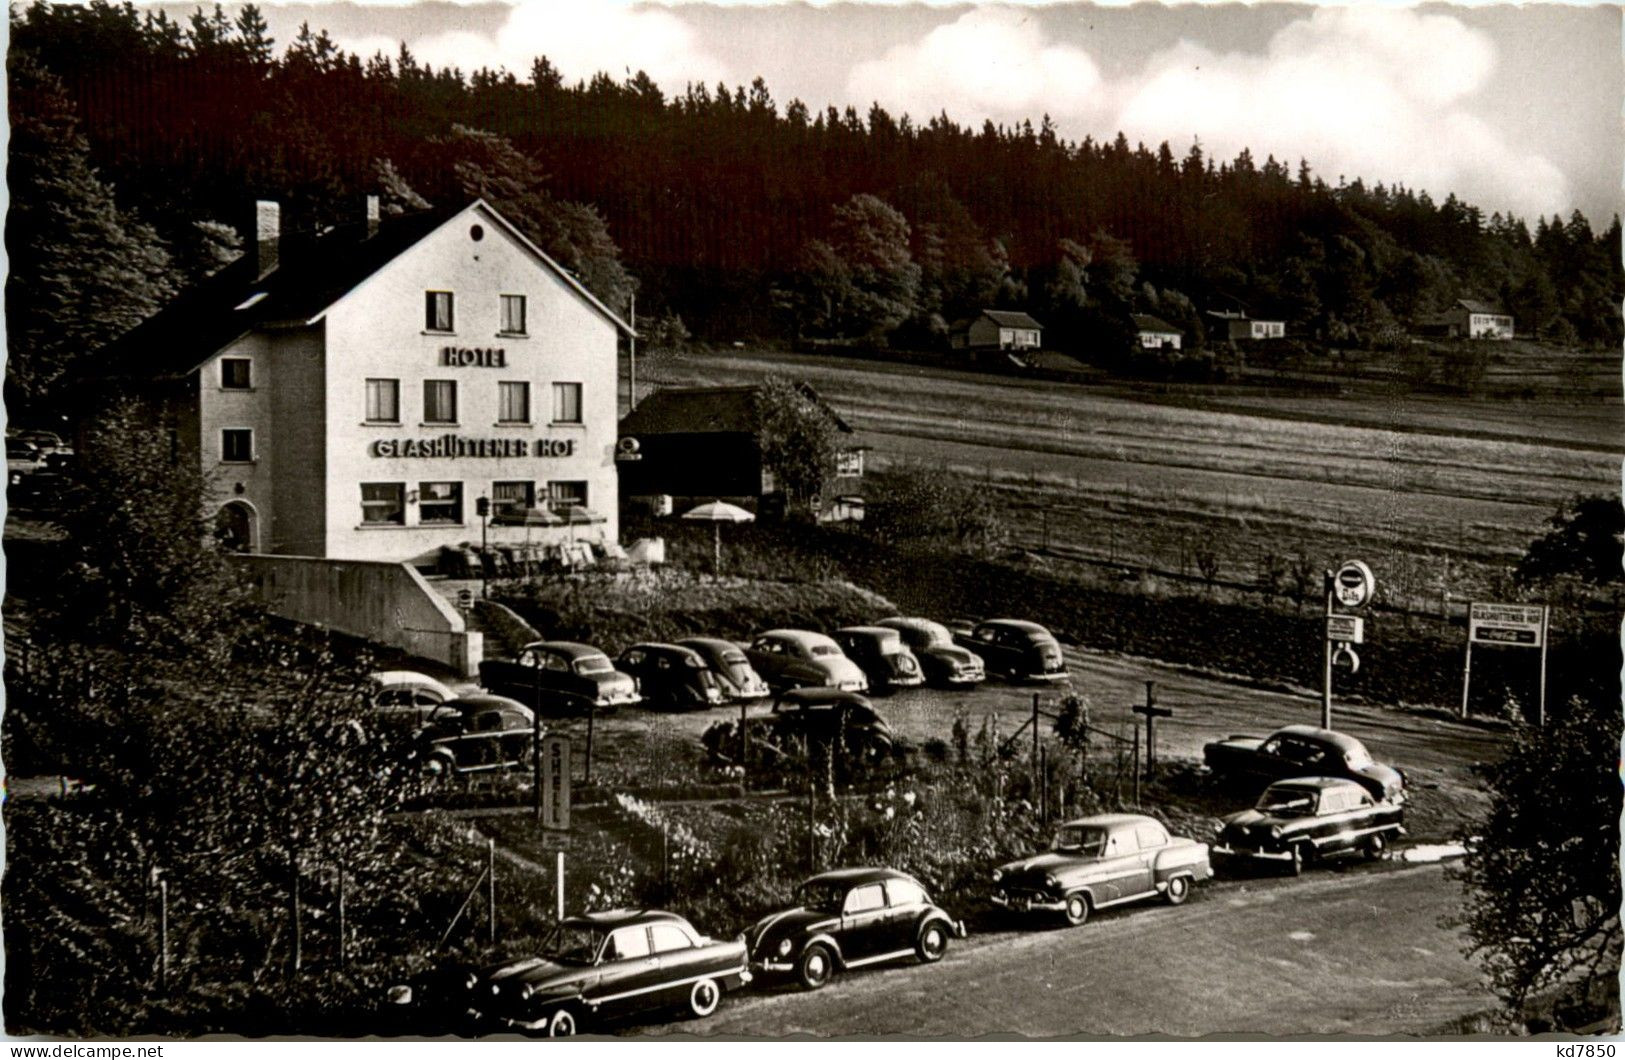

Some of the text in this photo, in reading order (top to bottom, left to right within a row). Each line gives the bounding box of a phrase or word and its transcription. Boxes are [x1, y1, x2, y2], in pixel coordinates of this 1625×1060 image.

[440, 347, 509, 368] HOTEL
[369, 434, 577, 459] GLASHÜTTENER HOF
[551, 742, 562, 823] SHELL
